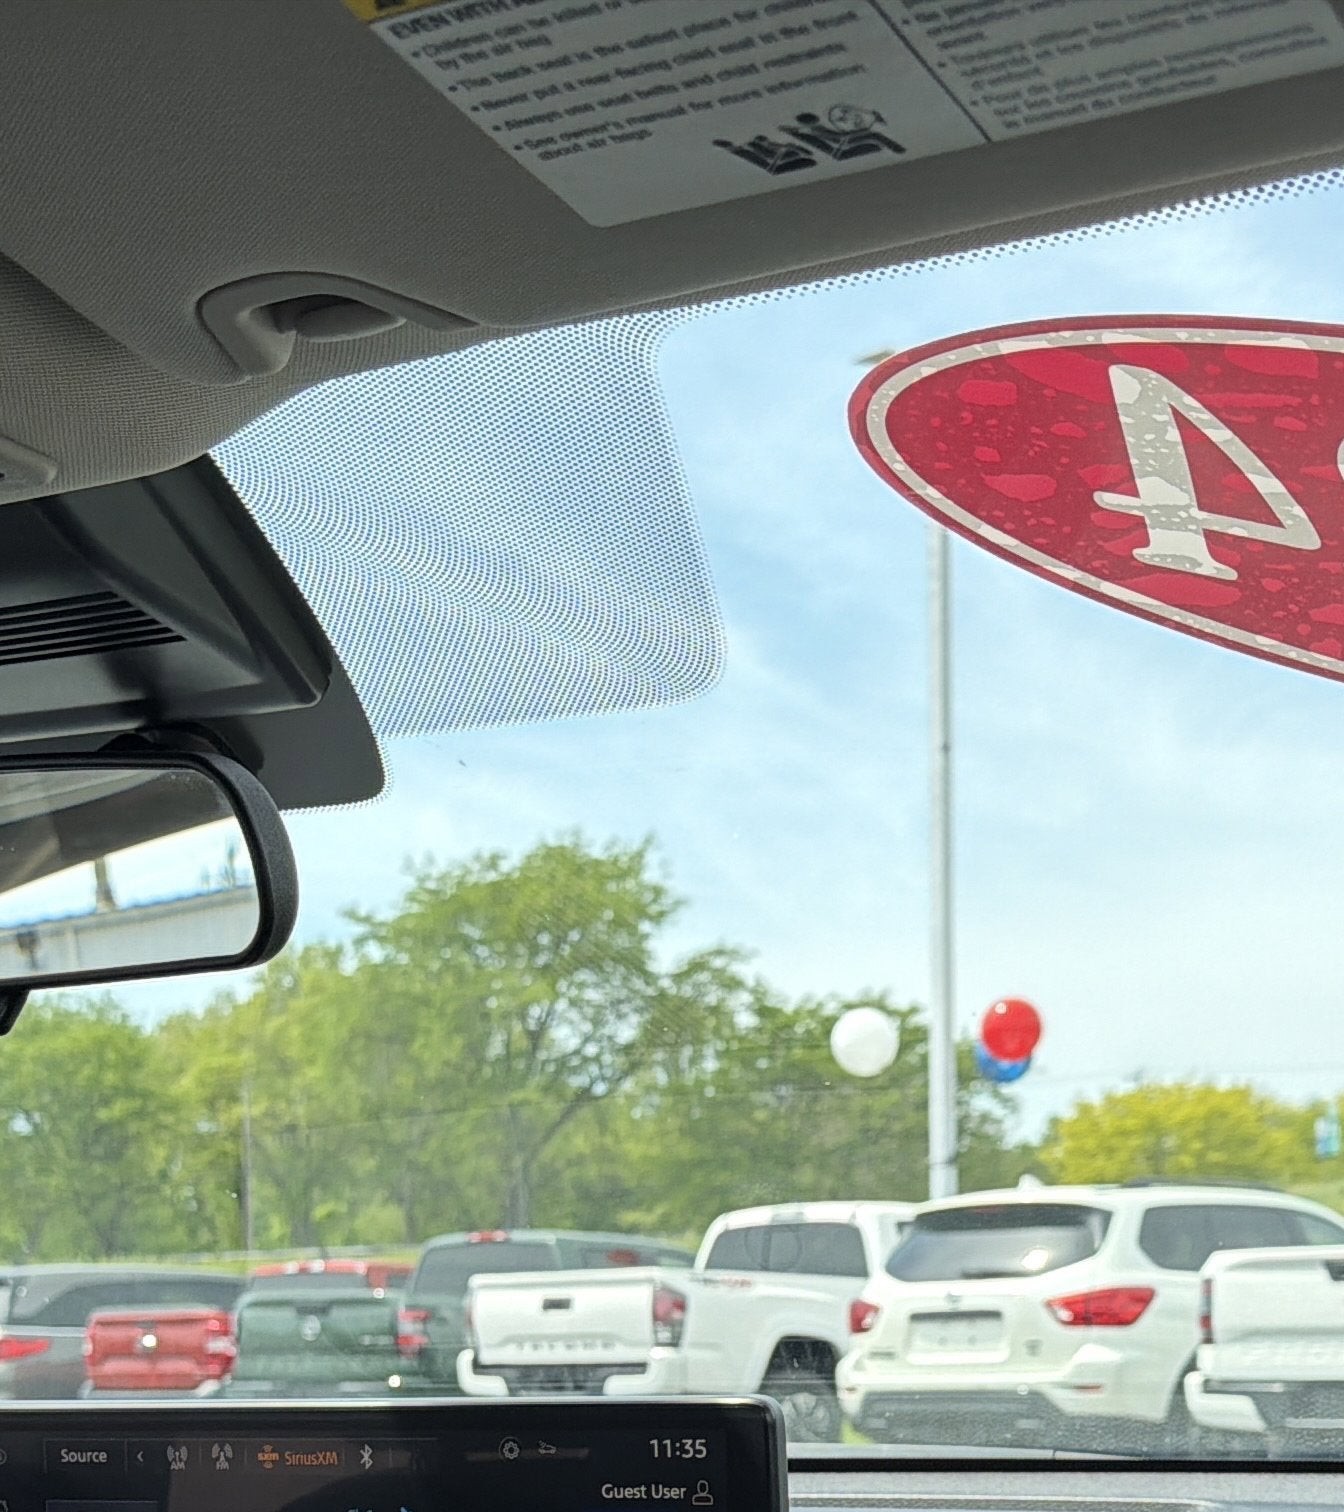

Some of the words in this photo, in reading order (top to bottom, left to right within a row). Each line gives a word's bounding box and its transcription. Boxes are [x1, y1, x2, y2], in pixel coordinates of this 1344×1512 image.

[61, 1448, 107, 1463] Source
[649, 1439, 707, 1458] 11:35
[285, 1451, 338, 1465] SiriusXM
[601, 1483, 647, 1499] Guest
[651, 1484, 687, 1499] User
